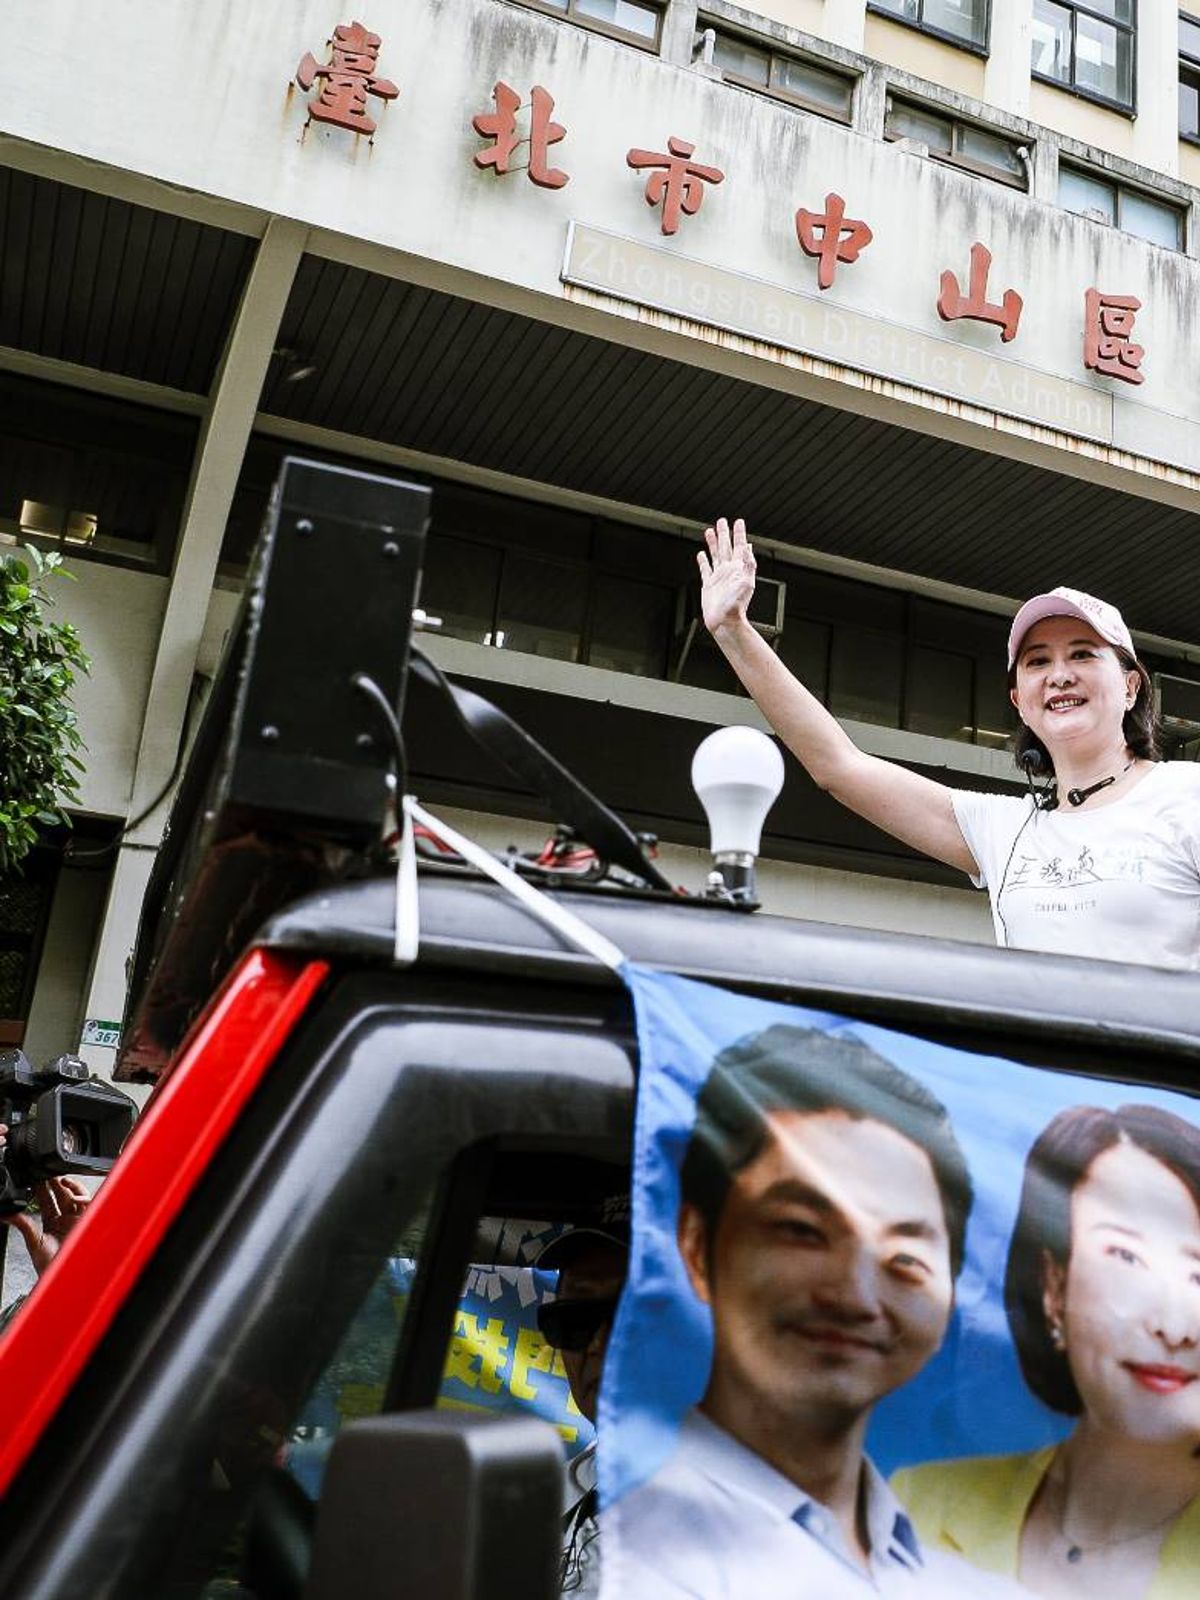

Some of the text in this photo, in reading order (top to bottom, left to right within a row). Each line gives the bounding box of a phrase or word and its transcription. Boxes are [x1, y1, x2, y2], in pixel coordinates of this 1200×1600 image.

[577, 238, 807, 338] Zhongshan
[822, 308, 968, 388] District
[95, 1031, 119, 1044] 367
